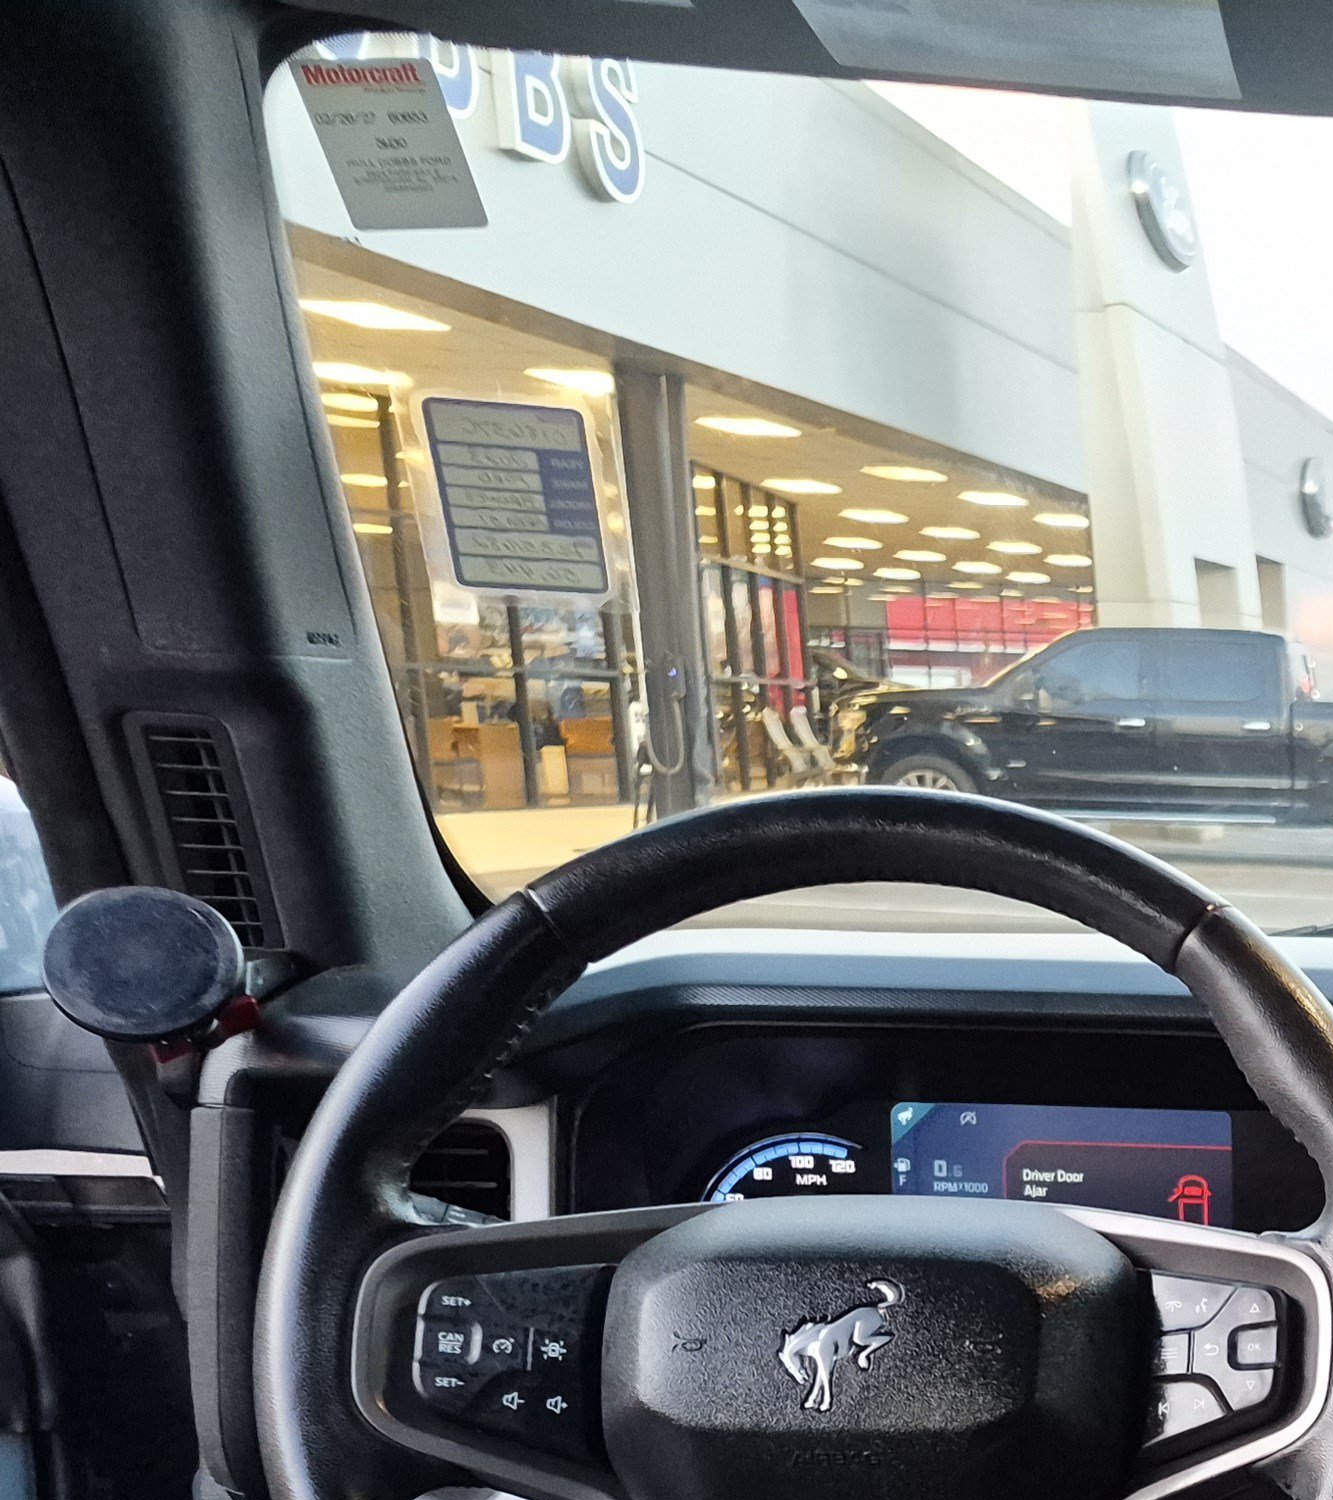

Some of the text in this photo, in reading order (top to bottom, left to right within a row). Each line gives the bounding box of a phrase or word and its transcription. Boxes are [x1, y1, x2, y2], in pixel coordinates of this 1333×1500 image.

[301, 63, 422, 86] Motorcraft
[788, 1156, 814, 1169] 100
[829, 1160, 856, 1173] 120
[796, 1174, 827, 1186] MPH
[1022, 1169, 1084, 1183] Driver Door
[1023, 1184, 1048, 1198] Ajar
[437, 1331, 464, 1343] CAN
[1247, 1342, 1262, 1351] OK
